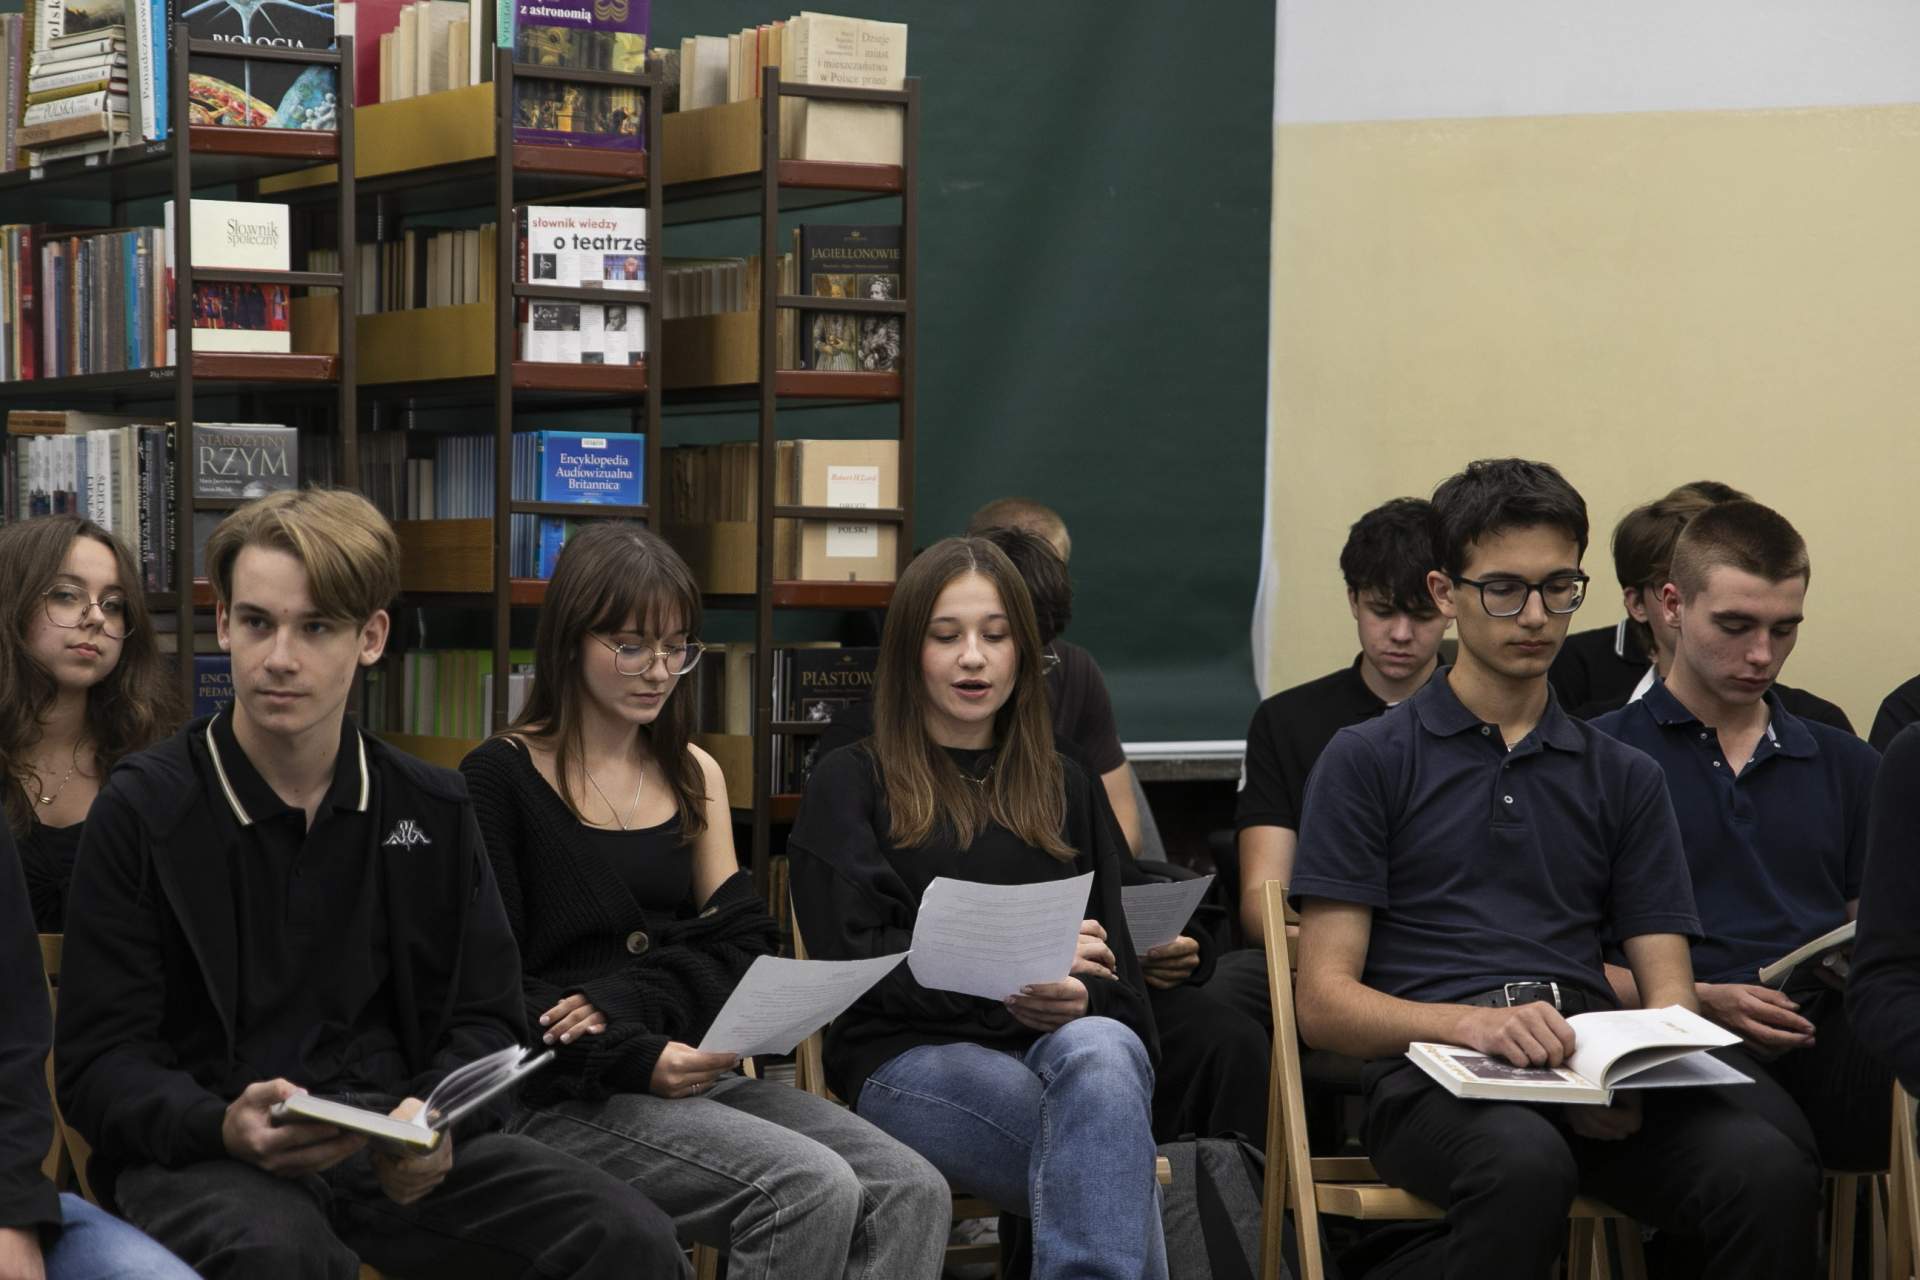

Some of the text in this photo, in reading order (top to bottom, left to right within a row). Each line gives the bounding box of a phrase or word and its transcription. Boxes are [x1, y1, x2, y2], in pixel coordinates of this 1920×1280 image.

[520, 5, 592, 23] z astronomią
[227, 218, 278, 236] Słownik
[532, 217, 618, 231] słownik wiedzy
[553, 234, 648, 251] o teatrze
[810, 247, 900, 260] JAGIELLONOWIE
[200, 446, 289, 476] RZYM
[560, 453, 629, 467] Encyklopedia
[555, 466, 633, 479] Audiowizualna
[568, 478, 619, 490] Britannica
